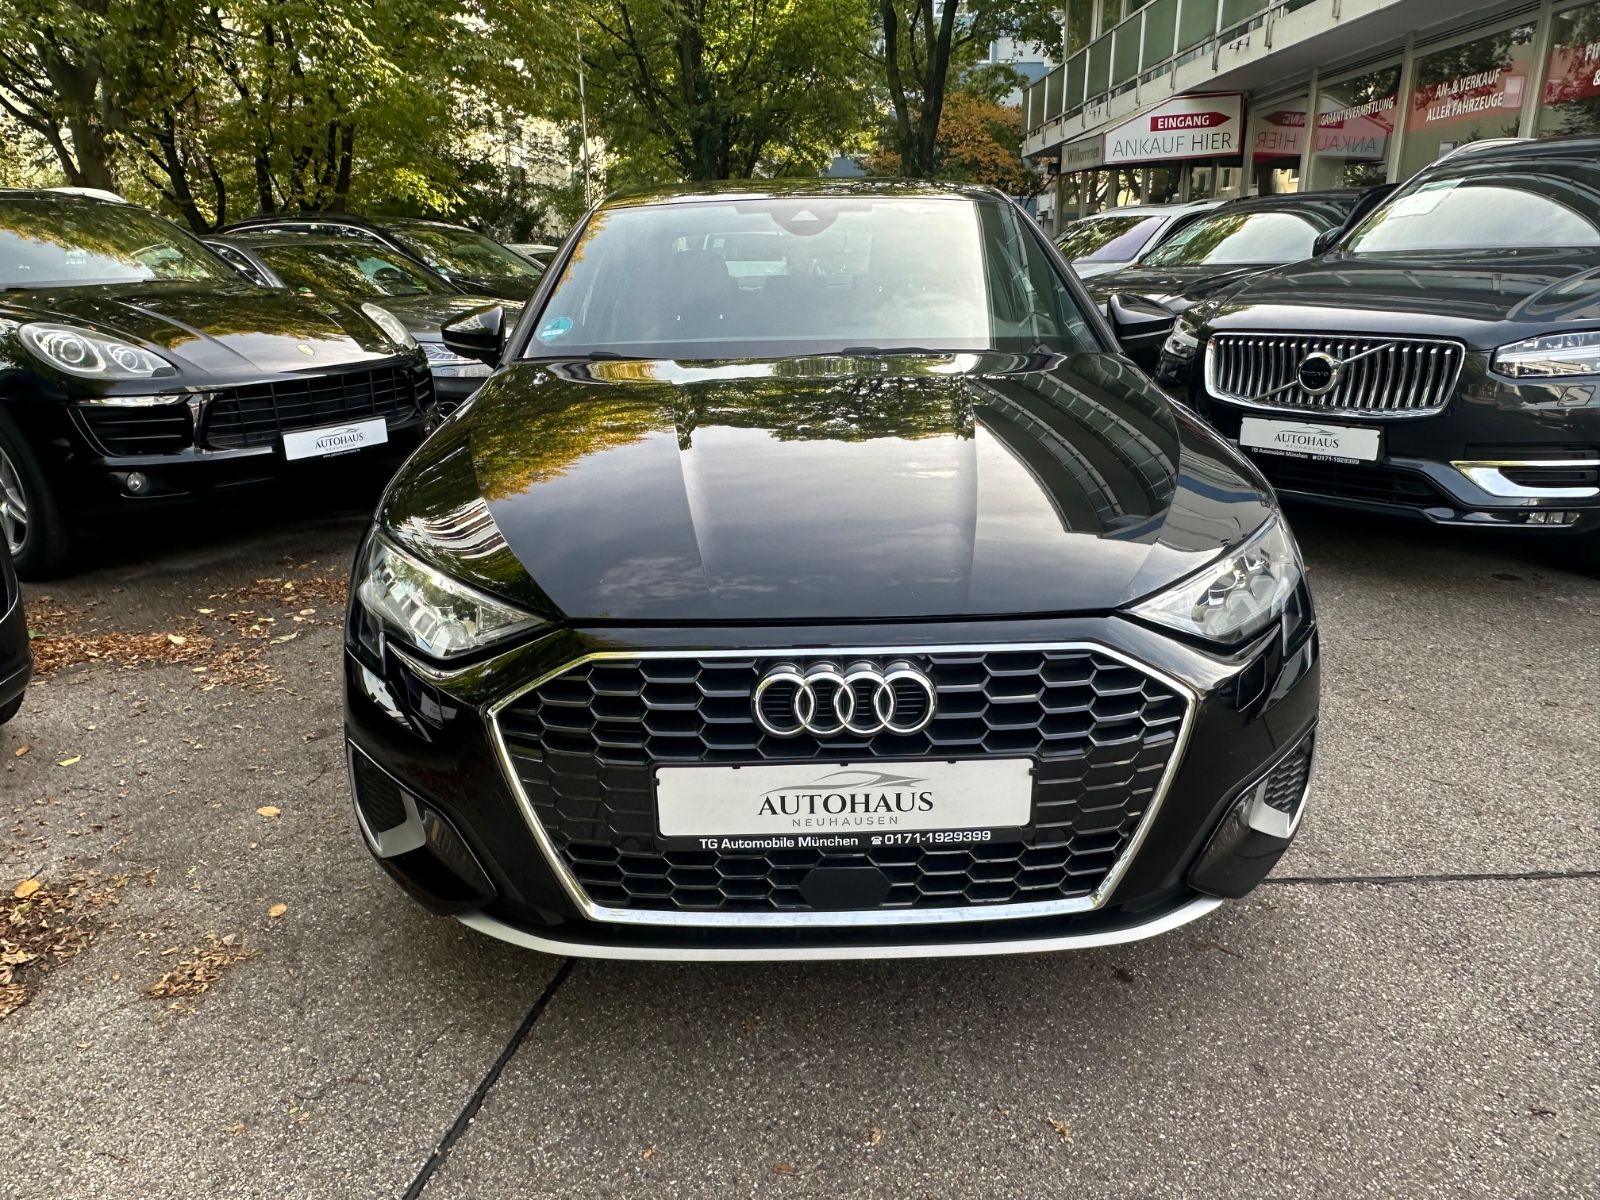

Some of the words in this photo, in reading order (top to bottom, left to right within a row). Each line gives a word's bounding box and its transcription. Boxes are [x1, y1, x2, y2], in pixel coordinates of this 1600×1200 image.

[1452, 79, 1461, 94] &
[1460, 69, 1501, 92] VERKAUF
[1320, 97, 1395, 126] GARANTIEVERMITTLUNG
[1426, 105, 1451, 122] ALLER
[1451, 92, 1504, 116] FAHRZEUGE
[1158, 115, 1210, 129] EINGANG
[1112, 135, 1185, 157] ANKAUF
[1191, 132, 1232, 151] HIER
[315, 432, 364, 449] AUTOHAUS
[1274, 433, 1339, 448] AUTOHAUS
[757, 791, 934, 816] AUTOHAUS
[792, 816, 898, 827] NEUHAUSEN
[699, 838, 718, 849] TG
[721, 836, 794, 849] Automobile
[798, 835, 859, 848] München
[884, 830, 991, 845] 0171-1929399
